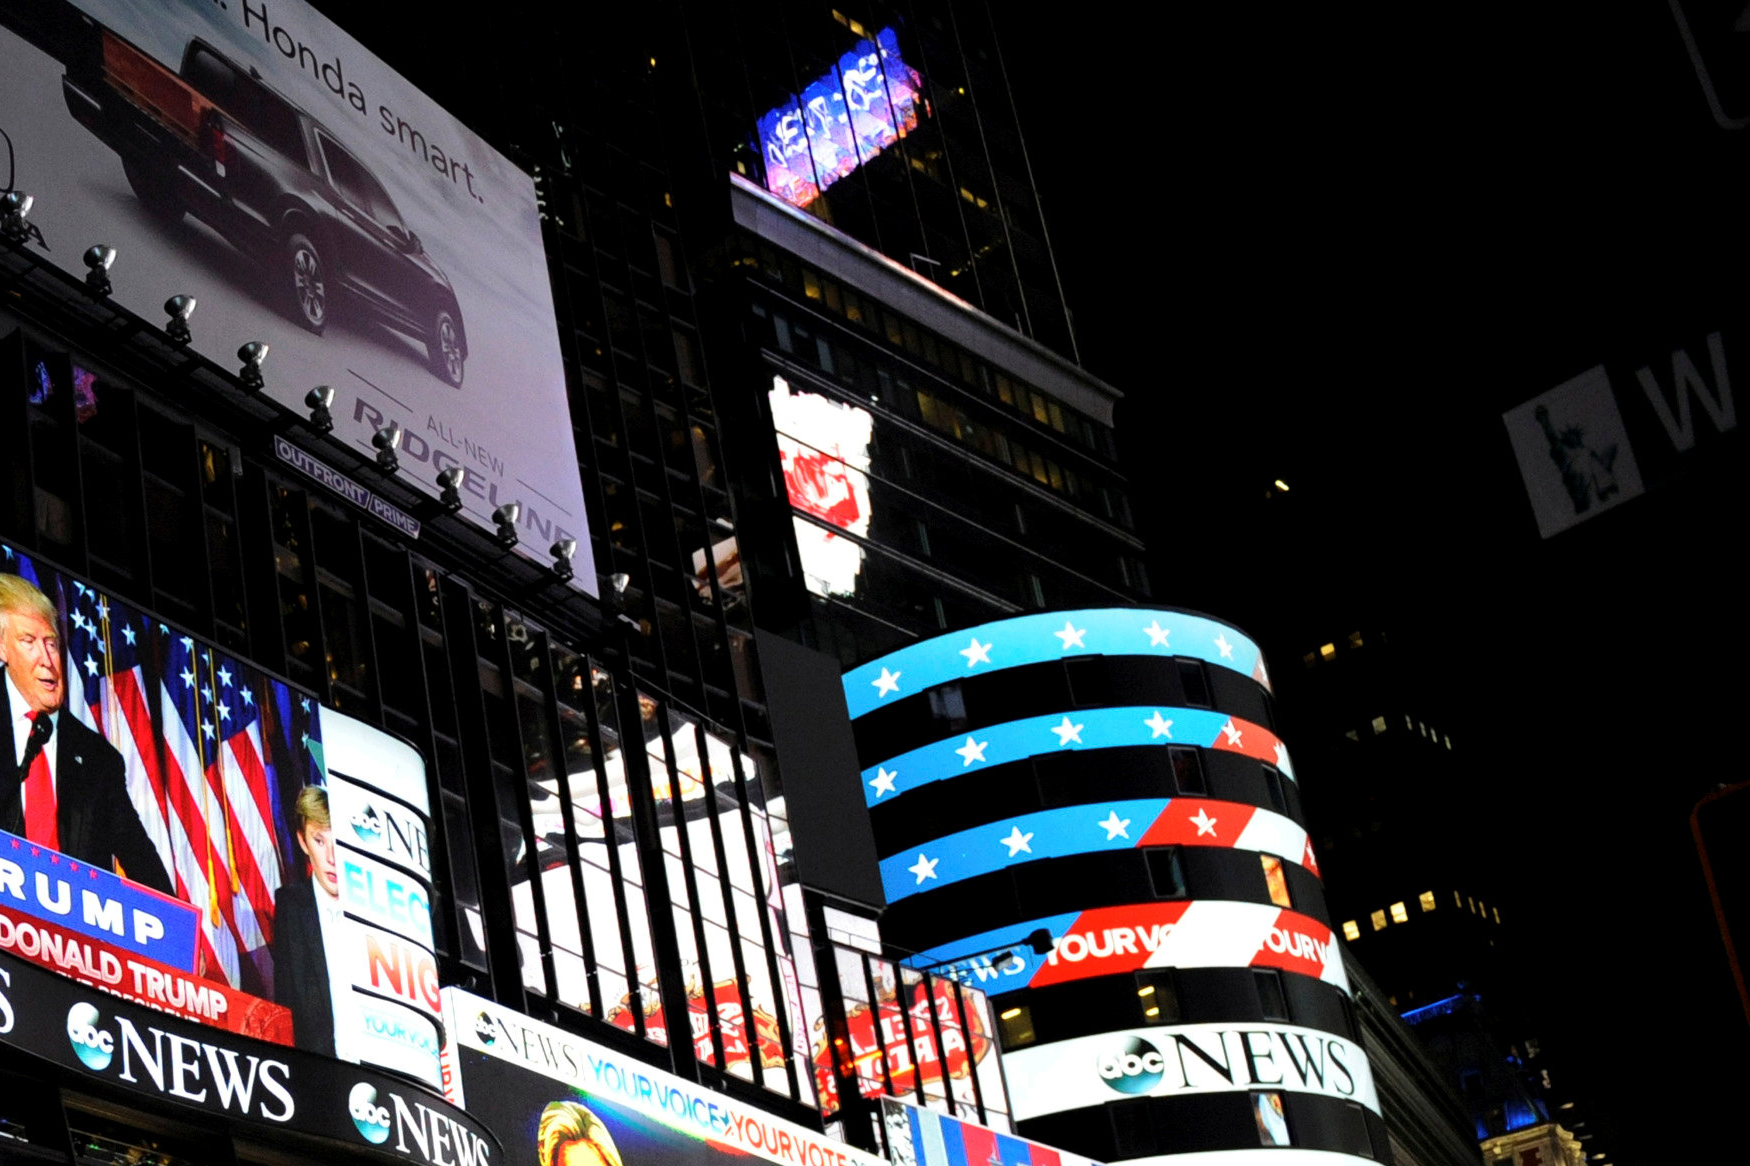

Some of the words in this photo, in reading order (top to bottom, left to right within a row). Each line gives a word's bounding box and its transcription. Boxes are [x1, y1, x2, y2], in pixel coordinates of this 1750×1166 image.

[241, 0, 367, 116] Honda
[379, 104, 485, 204] smart.
[1635, 331, 1738, 453] W
[427, 415, 505, 477] ALL-NEW
[278, 442, 366, 506] OUTFRONT
[374, 496, 419, 535] PRIME
[379, 809, 431, 873] NE
[343, 859, 430, 935] ELEC
[127, 959, 228, 1020] TRUMP
[365, 934, 442, 1014] NIG
[115, 1014, 296, 1123] NEWS
[496, 1016, 579, 1079] NEWS
[587, 1053, 652, 1104] YOUR
[654, 1079, 724, 1136] VOICE
[730, 1110, 795, 1162] YOUR
[1164, 1030, 1356, 1098] NEWS
